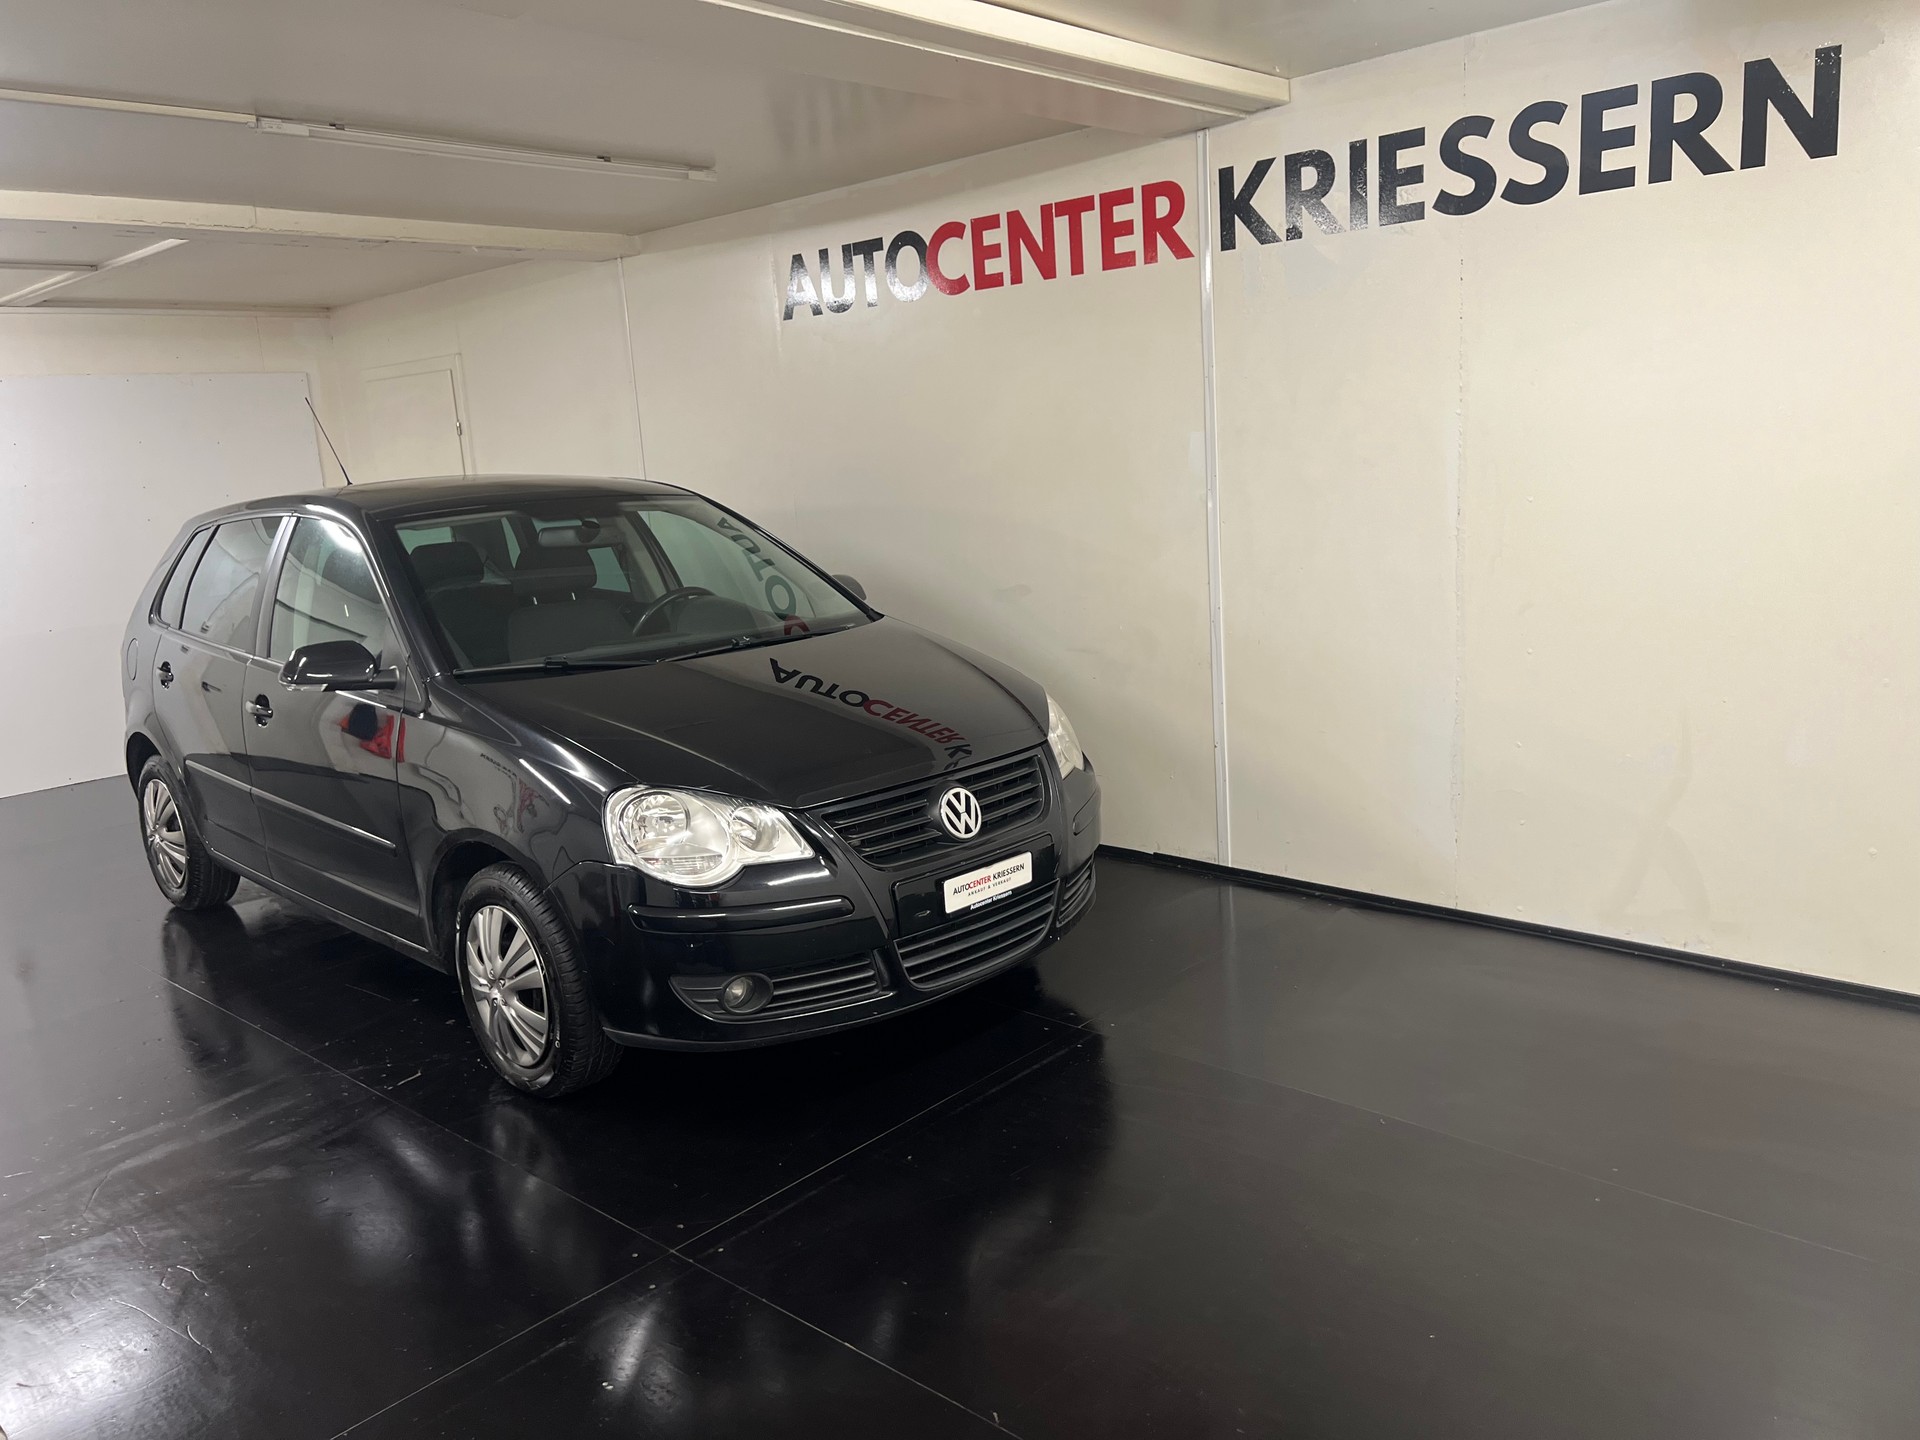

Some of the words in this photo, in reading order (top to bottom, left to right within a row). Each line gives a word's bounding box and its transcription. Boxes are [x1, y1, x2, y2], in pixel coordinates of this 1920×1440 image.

[783, 181, 1195, 321] AUTOCENTER
[1218, 44, 1843, 252] KRIESSERN
[953, 875, 992, 895] AUTOCENTER
[992, 863, 1025, 880] KRIESSERN
